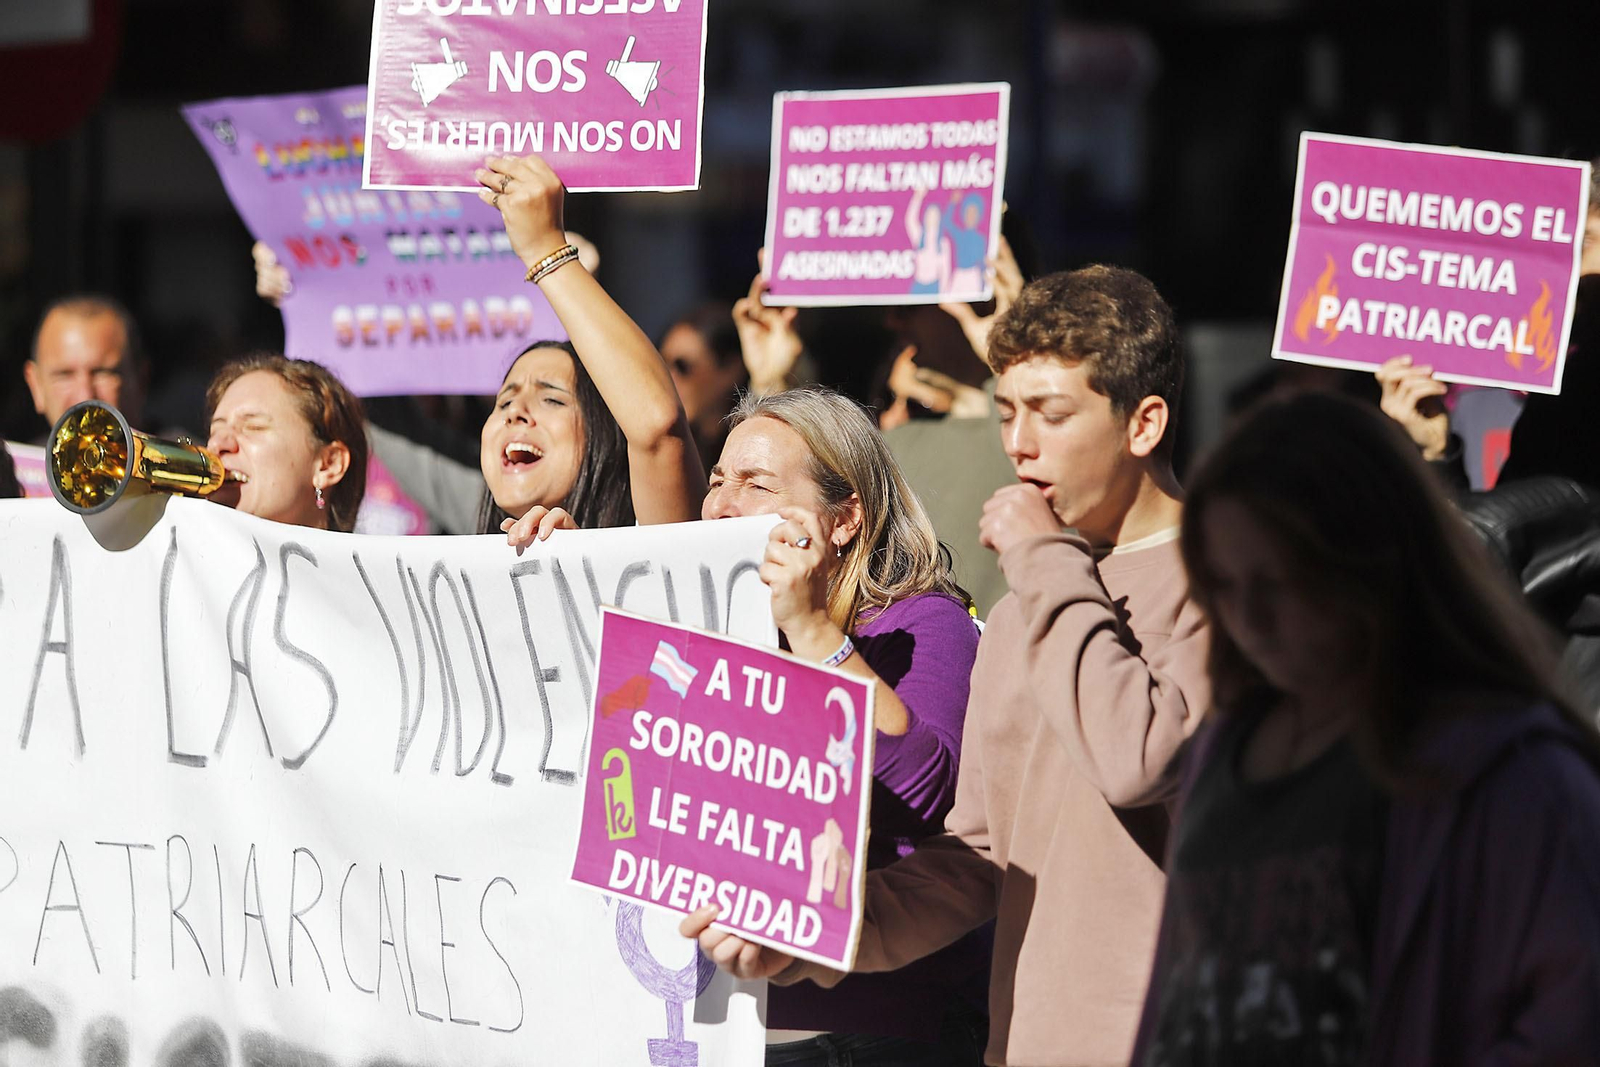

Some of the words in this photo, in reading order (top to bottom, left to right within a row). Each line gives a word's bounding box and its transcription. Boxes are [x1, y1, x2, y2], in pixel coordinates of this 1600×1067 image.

[488, 50, 588, 94] SON
[381, 115, 544, 153] MUERTES,
[554, 120, 624, 152] SON
[631, 119, 682, 151] NO
[789, 126, 829, 152] NO
[829, 123, 929, 151] ESTAMOS
[930, 118, 998, 148] TODAS
[787, 164, 843, 193] NOS
[845, 161, 940, 192] FALTAN
[942, 152, 995, 189] MÁS
[783, 206, 823, 238] DE
[824, 205, 894, 237] 1.237
[1311, 180, 1524, 238] QUEMEMOS
[1531, 206, 1573, 244] EL
[778, 250, 916, 280] ASESINADAS
[1351, 243, 1518, 295] CIS-TEMA
[331, 295, 533, 348] SEPARADO
[1315, 295, 1535, 355] PATRIARCAL
[158, 525, 338, 770] LAS
[704, 659, 732, 702] A
[742, 665, 787, 714] TU
[629, 710, 838, 804] SORORIDAD
[648, 787, 691, 835] LE
[697, 800, 805, 871] FALTA
[608, 849, 823, 948] DIVERSIDAD
